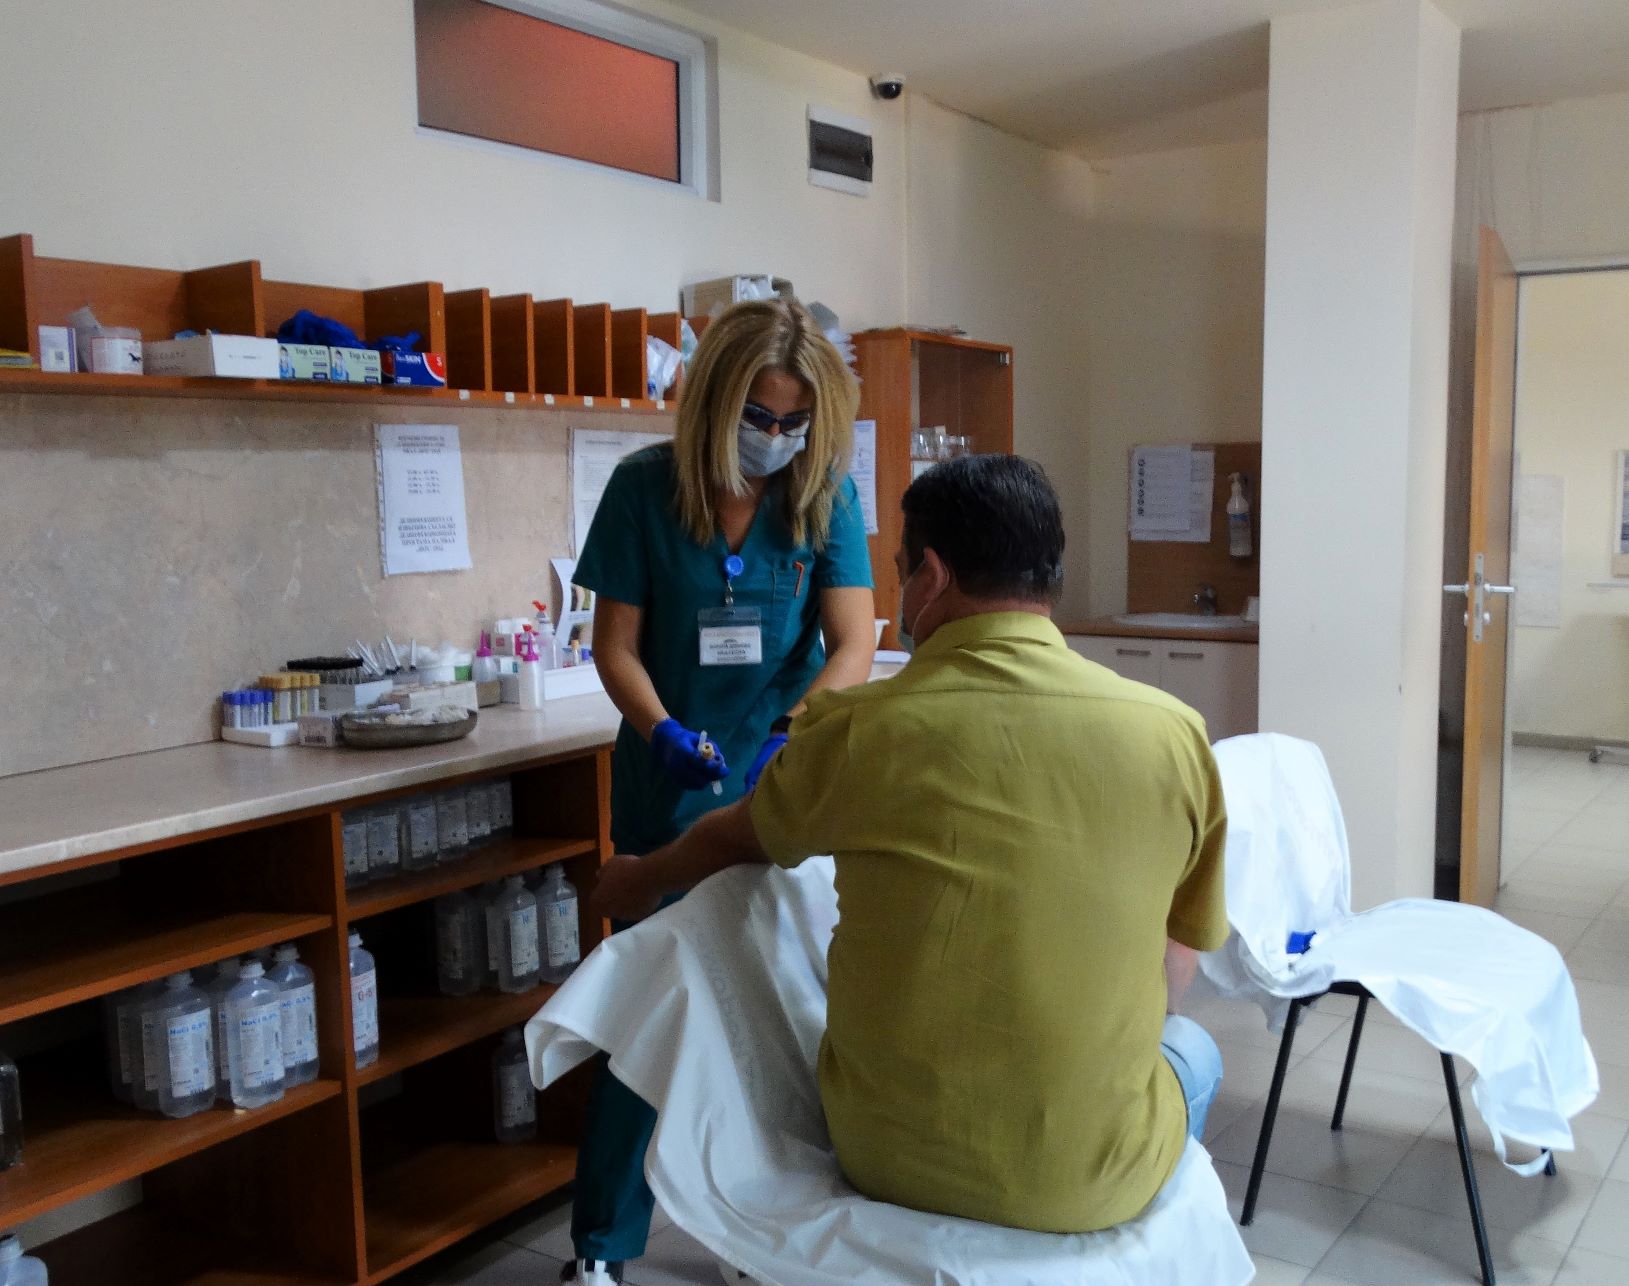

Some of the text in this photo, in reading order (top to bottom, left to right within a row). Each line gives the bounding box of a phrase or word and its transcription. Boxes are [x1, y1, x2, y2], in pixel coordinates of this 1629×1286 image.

[295, 346, 327, 356] Top Care
[348, 350, 378, 361] Top Care
[436, 356, 443, 367] S
[170, 1026, 189, 1035] NaCl
